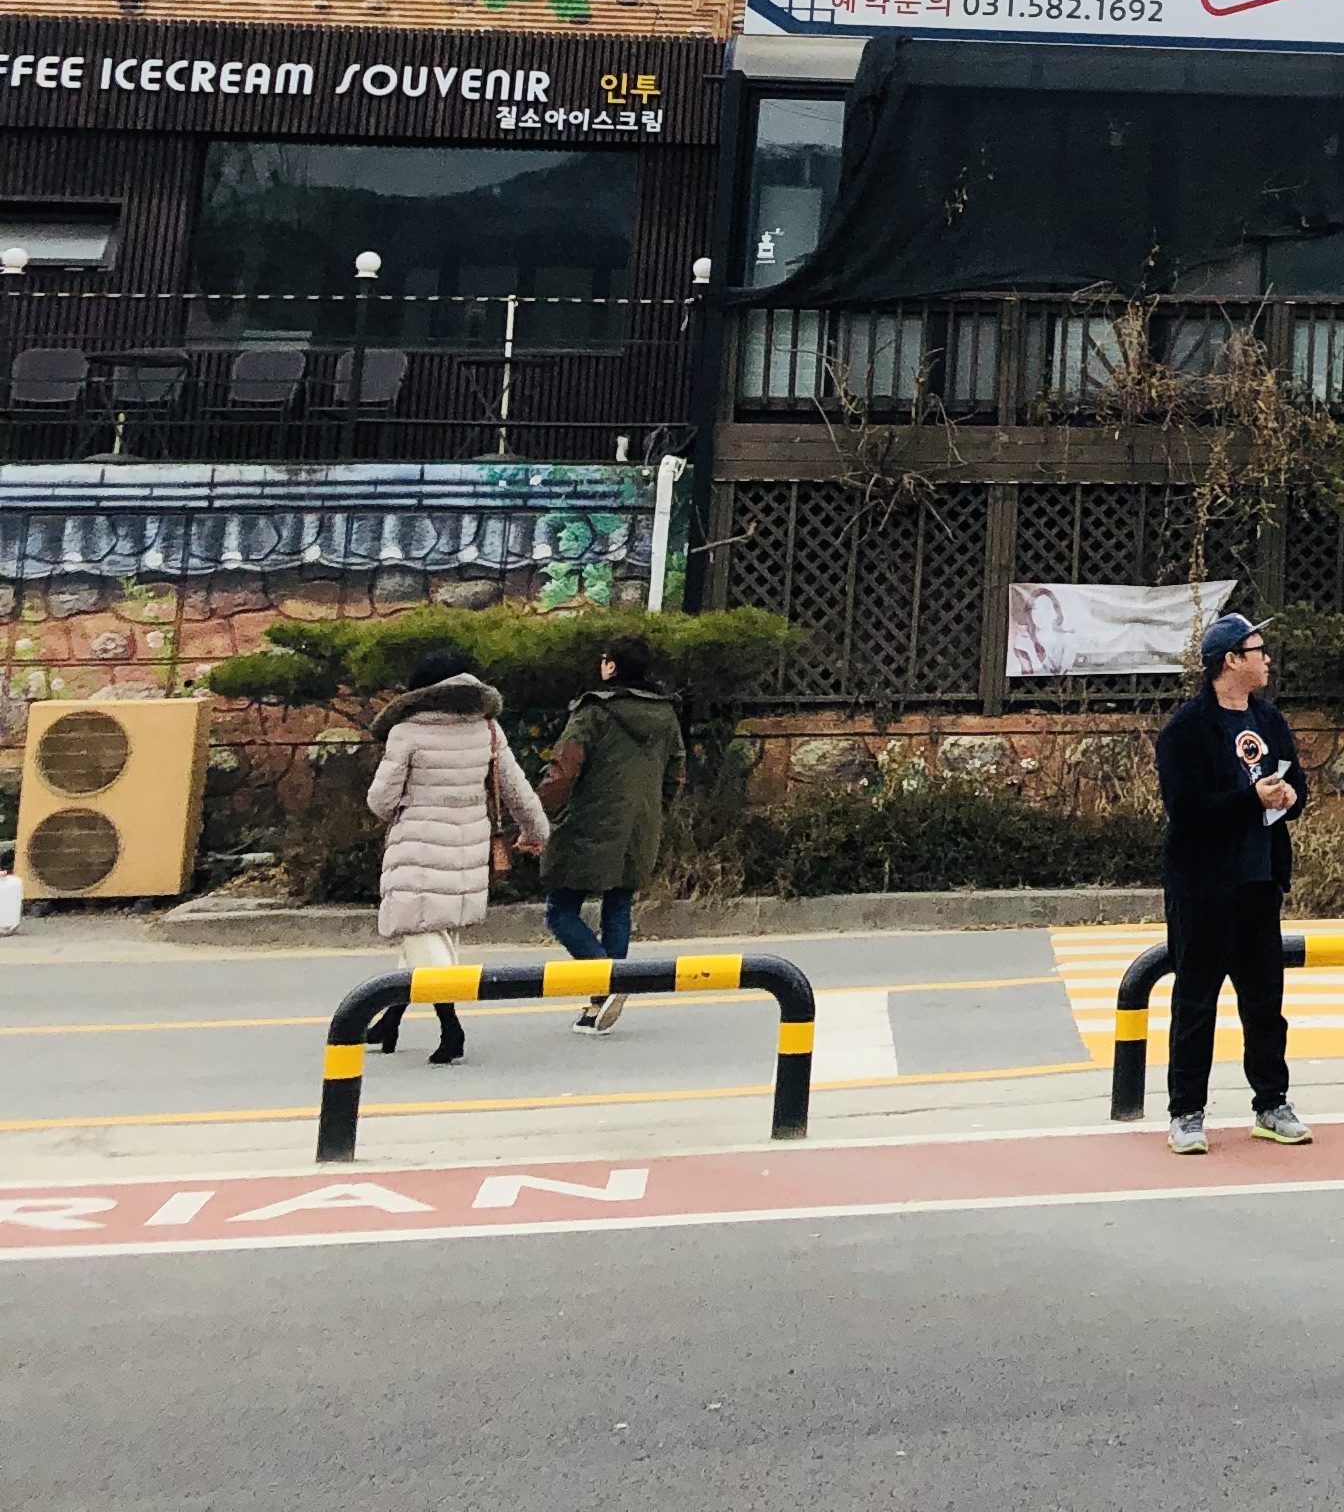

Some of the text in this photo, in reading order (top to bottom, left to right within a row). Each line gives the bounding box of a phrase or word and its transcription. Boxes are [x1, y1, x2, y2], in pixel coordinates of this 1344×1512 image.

[100, 57, 314, 96] ICECREAM
[335, 62, 551, 104] SOUVENIR
[601, 72, 661, 104] 인투
[496, 105, 664, 133] 질소아이스크림
[0, 1168, 649, 1230] RIAN
